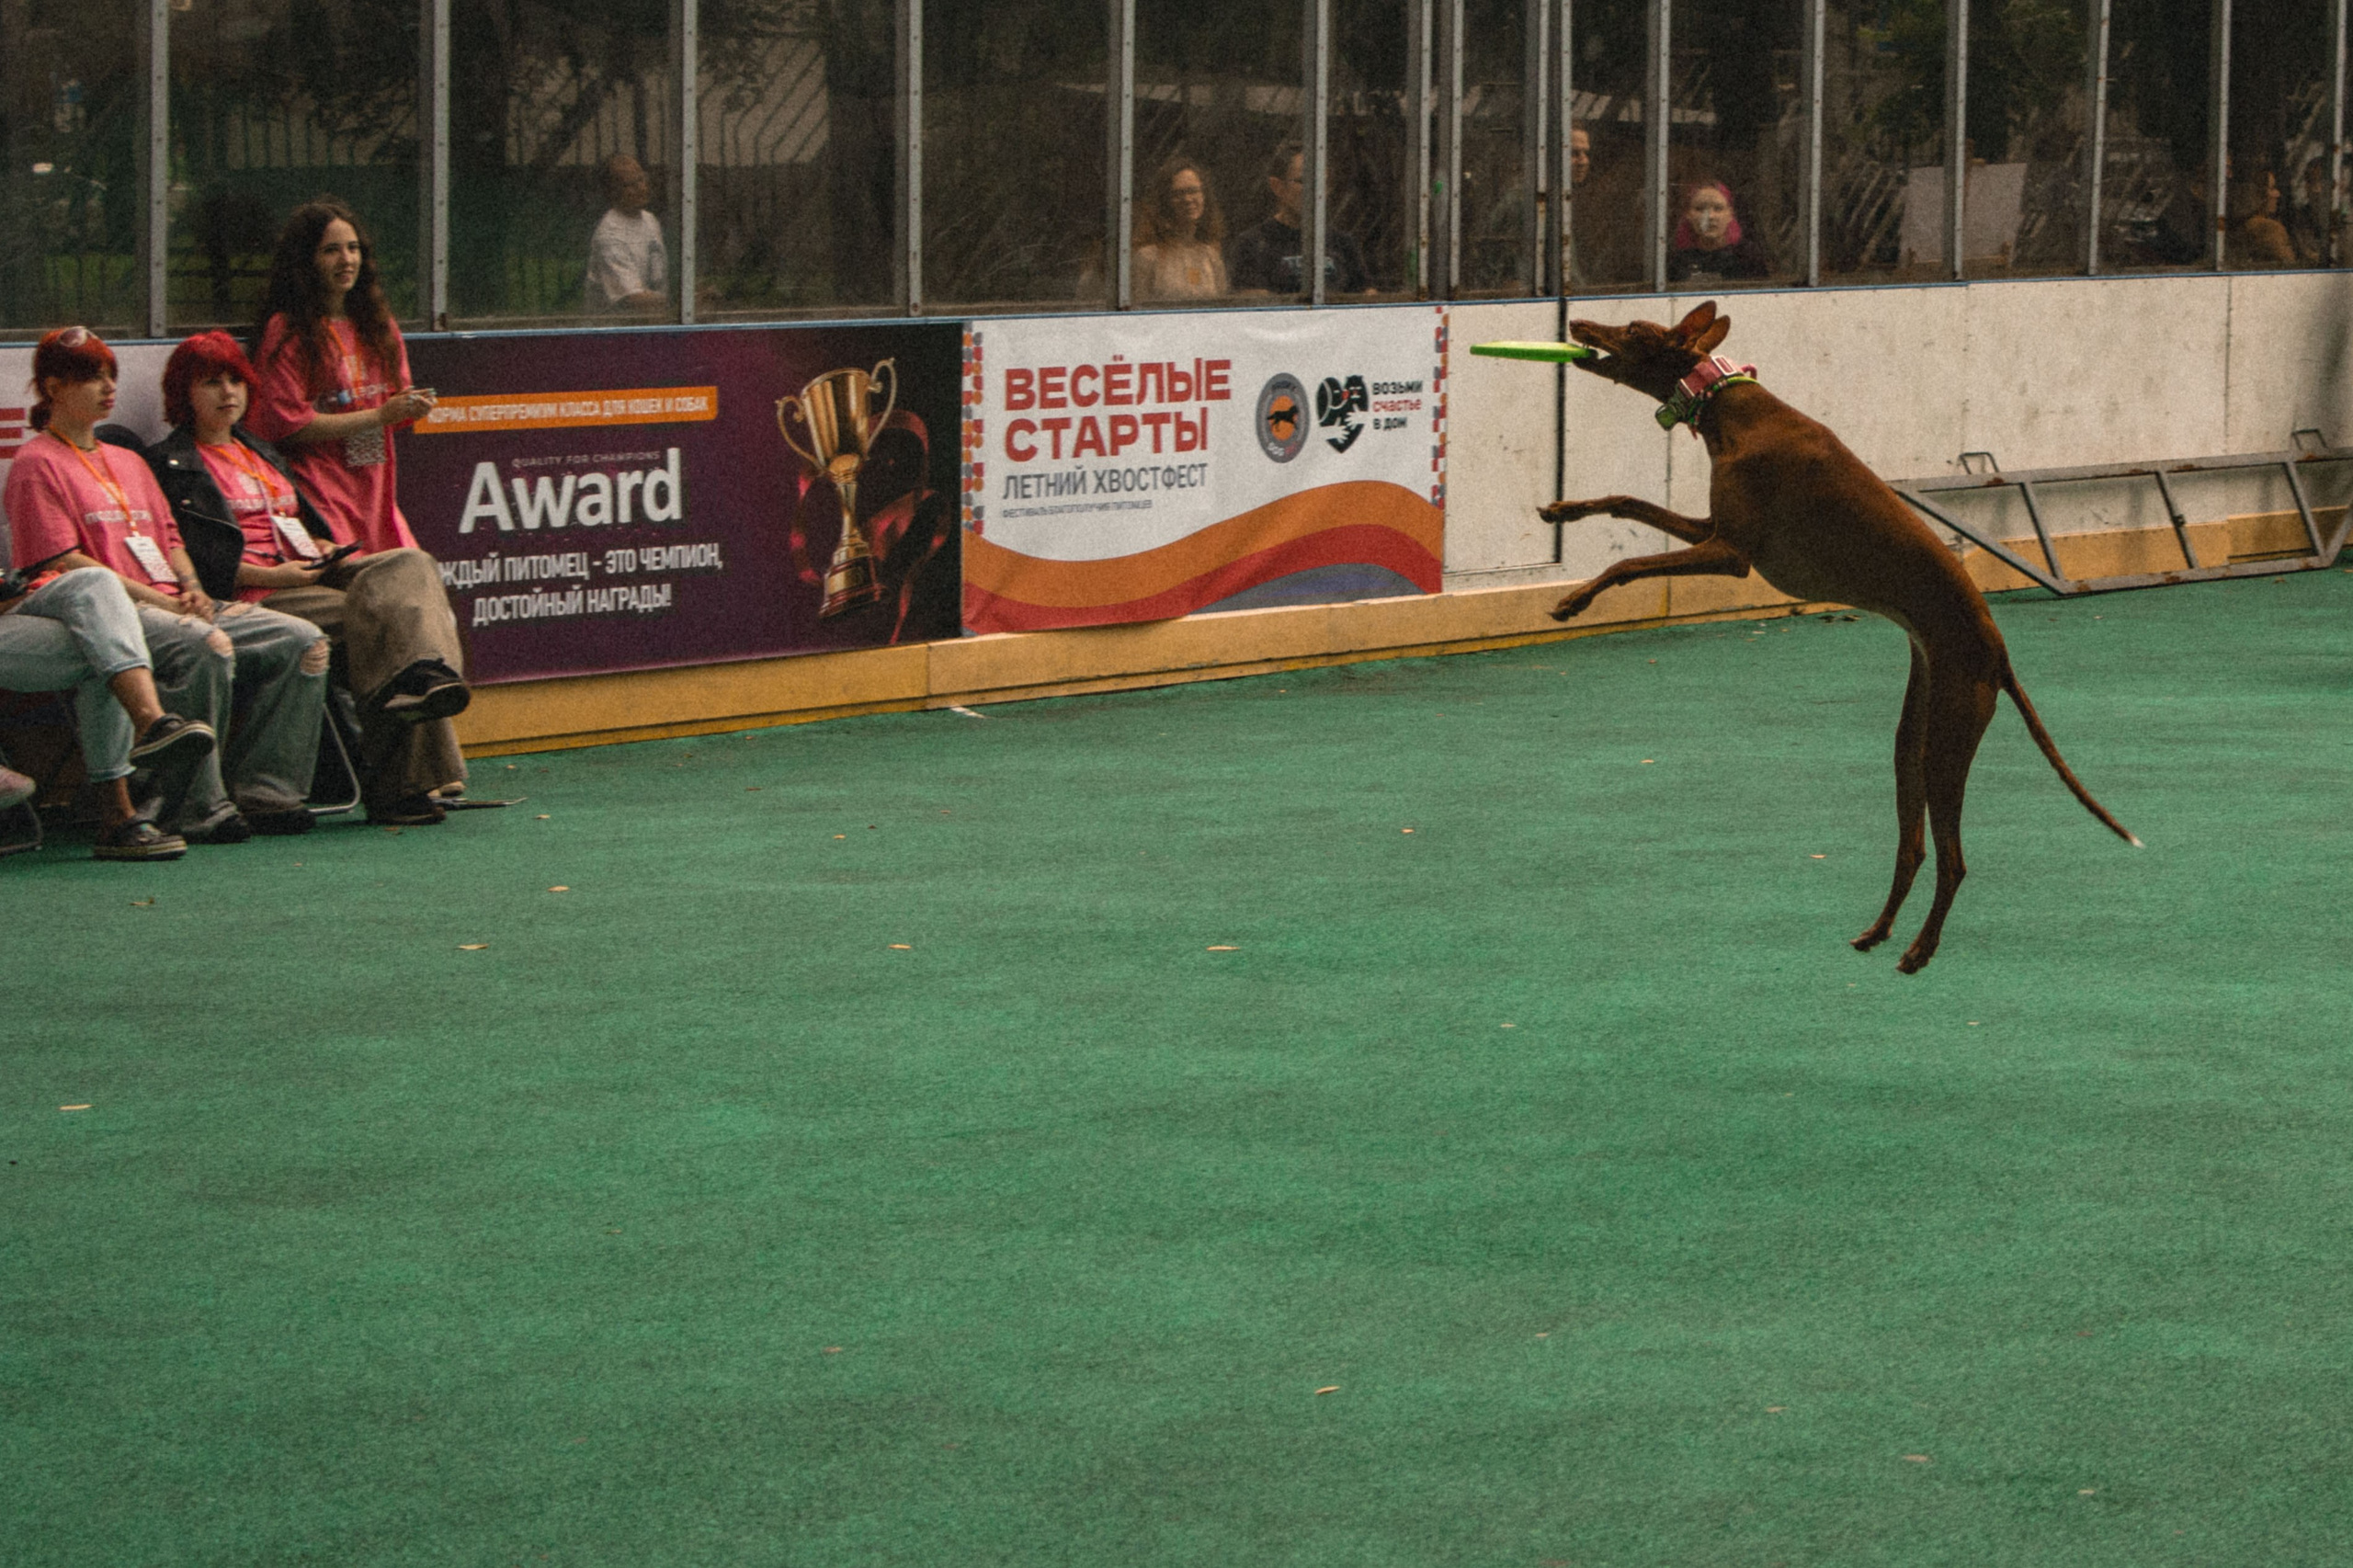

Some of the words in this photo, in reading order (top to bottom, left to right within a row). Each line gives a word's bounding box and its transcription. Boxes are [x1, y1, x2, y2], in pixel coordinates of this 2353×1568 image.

[1005, 354, 1232, 411] ВЕСЁЛЫЕ
[1372, 380, 1423, 395] ВОЗЬМИ
[1372, 398, 1422, 413] счастье
[1005, 406, 1209, 462] СТАРТЫ
[565, 454, 589, 464] FOR
[458, 447, 683, 534] Award
[1003, 465, 1087, 500] ЛЕТНИЙ
[1093, 462, 1209, 494] ХВОСТФЕСТ
[505, 551, 591, 581] ПИТОМЕЦ
[605, 549, 637, 574] ЭТО
[640, 542, 723, 571] ЧЕМПИОН,
[472, 584, 585, 627] ДОСТОЙНЫЙ
[586, 583, 672, 613] НАГРАДЫ!
